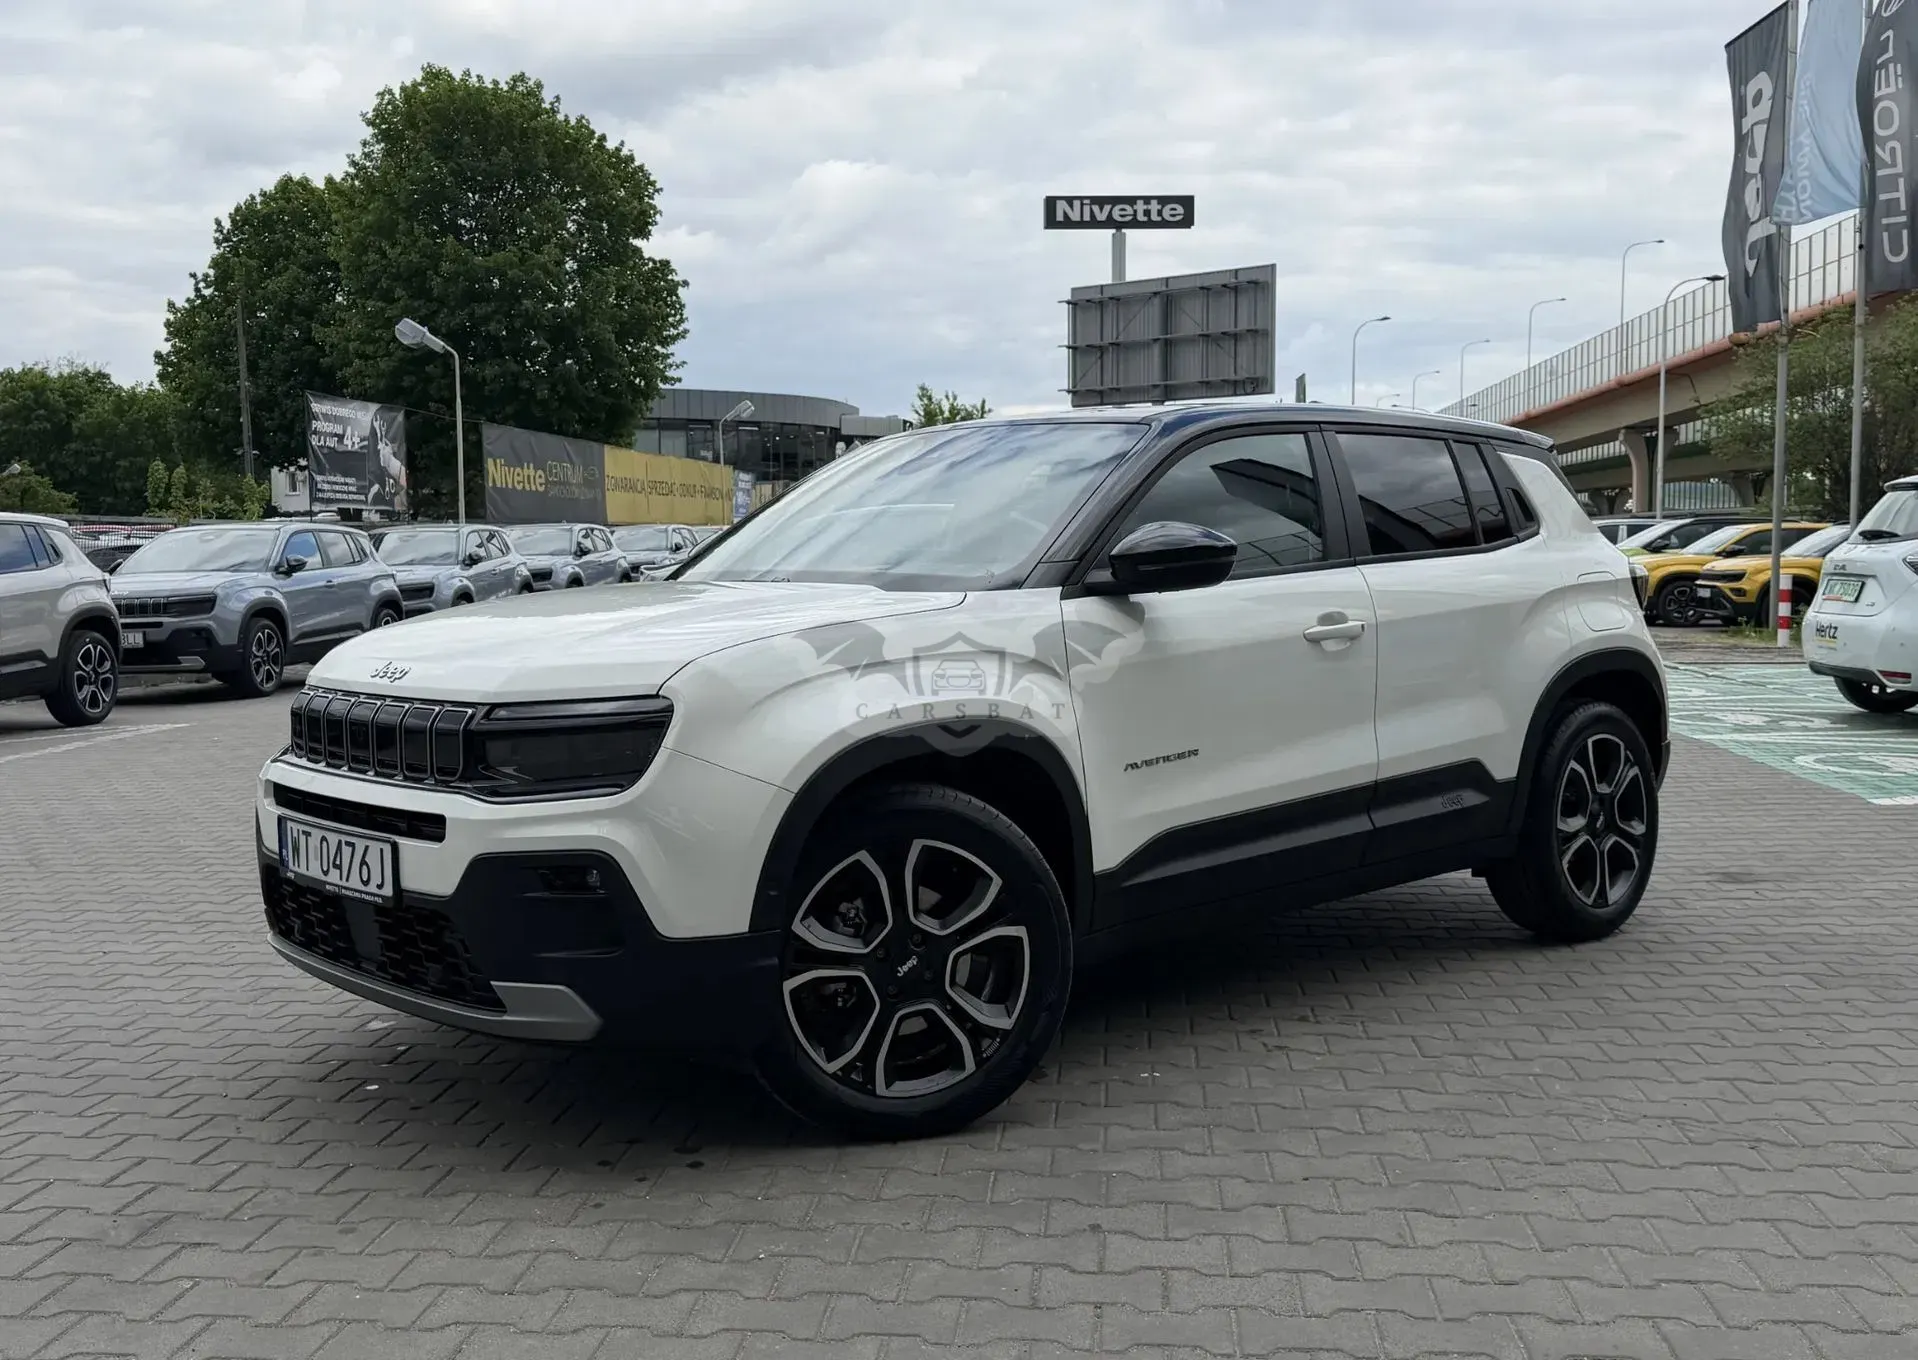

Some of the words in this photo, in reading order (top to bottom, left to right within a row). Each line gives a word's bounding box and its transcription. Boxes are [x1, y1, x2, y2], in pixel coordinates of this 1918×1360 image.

[1055, 199, 1185, 222] Nivette
[311, 420, 343, 435] PROGRAM
[343, 426, 361, 450] 4+
[311, 434, 324, 447] DLA
[325, 436, 339, 449] AUT
[487, 457, 546, 492] Nivette
[546, 460, 584, 485] CENTRUM
[1815, 619, 1839, 640] Hertz
[370, 661, 411, 683] Jeep
[1123, 748, 1200, 772] AVENGER
[290, 826, 312, 871] WT
[319, 834, 385, 891] 0476J
[897, 955, 918, 976] Jeep
